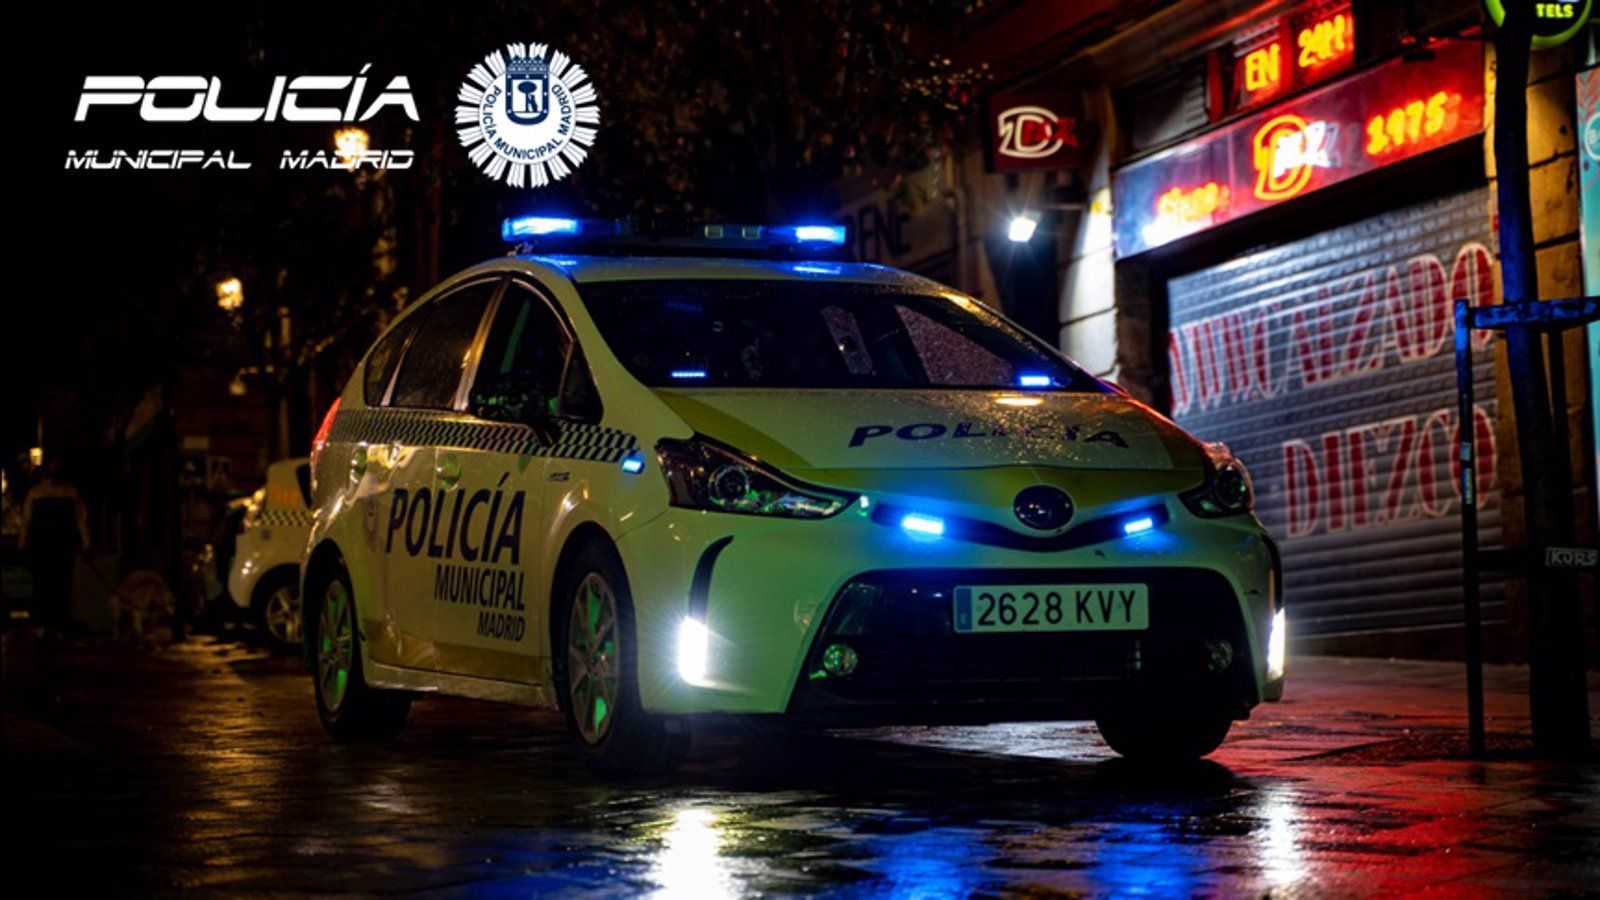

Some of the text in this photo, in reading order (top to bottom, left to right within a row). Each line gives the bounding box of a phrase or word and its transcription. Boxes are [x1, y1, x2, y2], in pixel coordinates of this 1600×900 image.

[1535, 3, 1574, 18] TELS
[1245, 44, 1279, 90] EN
[385, 472, 526, 566] POLICÍA
[434, 564, 526, 611] MUNICIPAL
[978, 590, 1136, 626] 2628 KVY
[477, 612, 526, 641] MADRID
